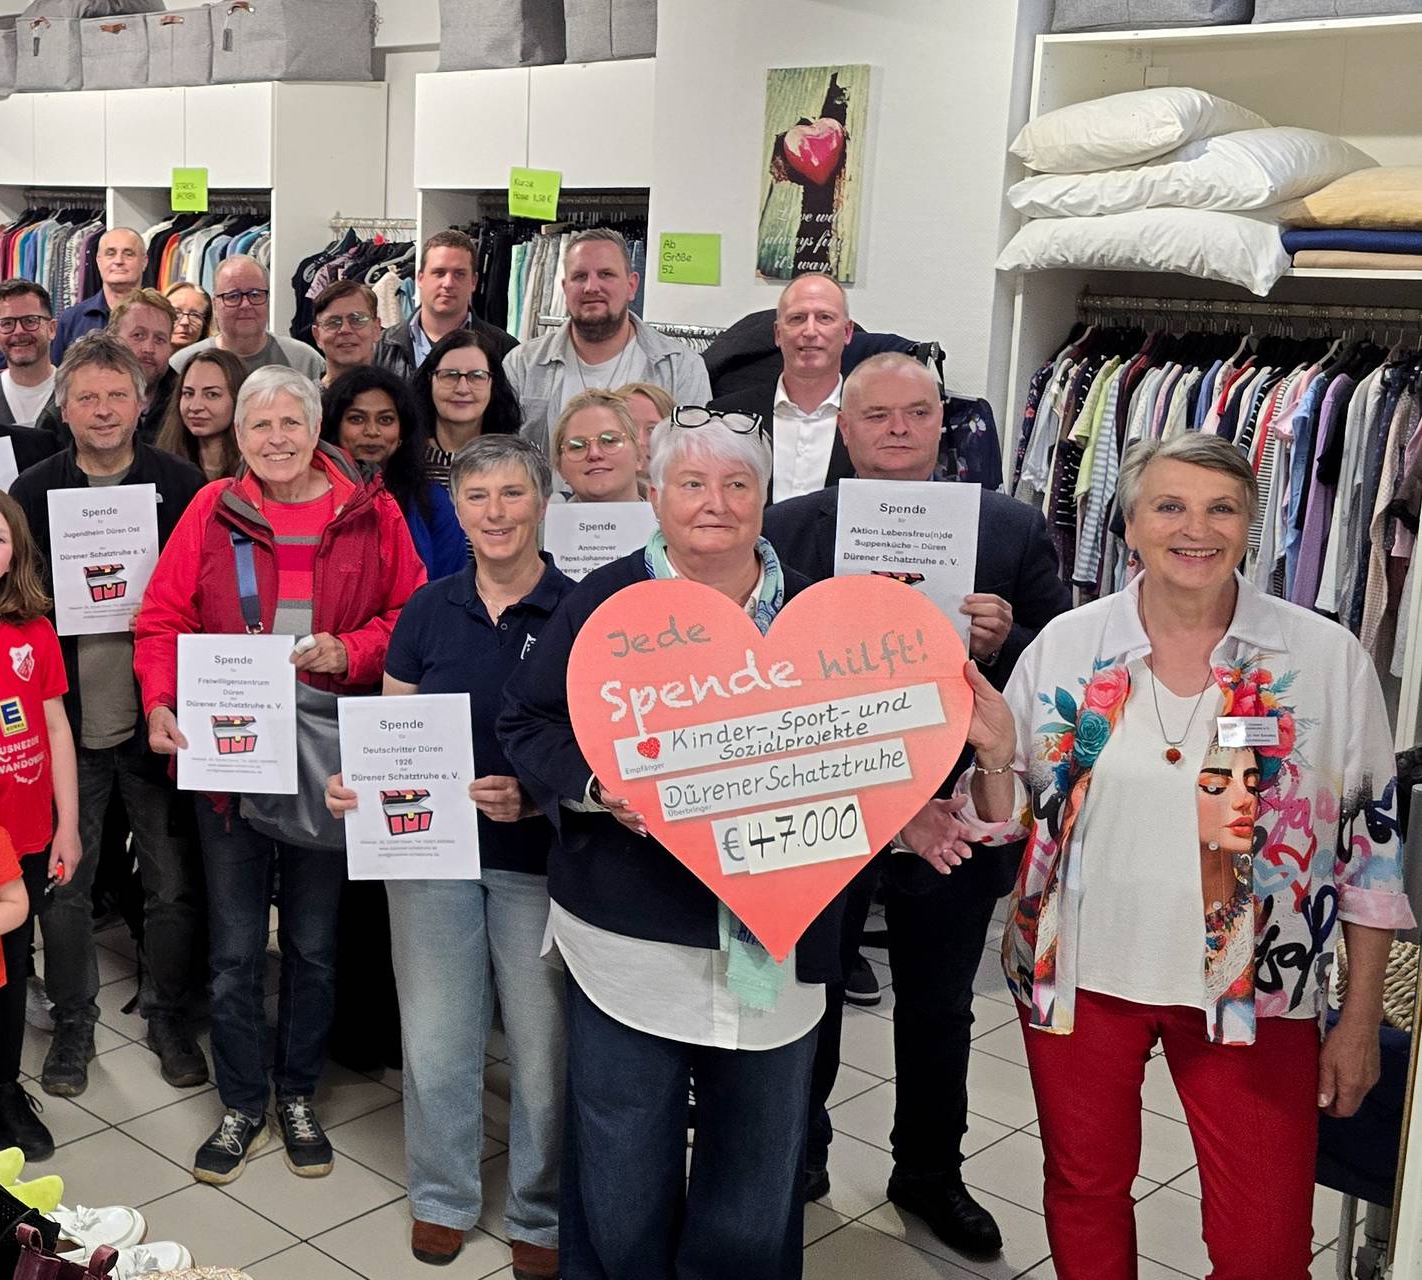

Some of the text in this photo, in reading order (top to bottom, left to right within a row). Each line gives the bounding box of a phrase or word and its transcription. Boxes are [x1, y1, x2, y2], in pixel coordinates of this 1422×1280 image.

[663, 239, 676, 249] Ab
[663, 251, 692, 262] Größe
[662, 264, 675, 274] 52
[82, 507, 118, 518] Spende
[880, 502, 927, 515] Spende
[63, 530, 104, 539] Jugendheim
[106, 527, 126, 535] Düren
[578, 522, 616, 532] Spende
[850, 526, 954, 540] Aktion Lebensfreu(n)de
[854, 539, 912, 550] Suppenküche
[921, 543, 947, 551] Düren
[60, 552, 89, 560] Dürener
[90, 550, 132, 558] Schatztruhe
[843, 552, 880, 561] Dürener
[882, 555, 937, 566] Schatztruhe
[607, 614, 712, 658] Jede
[214, 655, 254, 665] Spende
[198, 678, 270, 686] Freiwilligenzentrum
[600, 629, 929, 737] Spende hilft!
[186, 700, 216, 708] Dürener
[218, 701, 264, 710] Schatztruhe
[778, 704, 851, 731] Sport-
[859, 692, 912, 718] und
[378, 720, 424, 732] Spende
[719, 721, 870, 760] Sozialprojekte
[362, 744, 444, 754] Deutschritter Düren
[625, 762, 666, 775] Empfänger
[351, 772, 386, 782] Dürener
[388, 772, 440, 782] Schatztruhe
[452, 772, 460, 780] V.
[668, 804, 712, 817] Überbringer
[748, 803, 858, 859] 47.000
